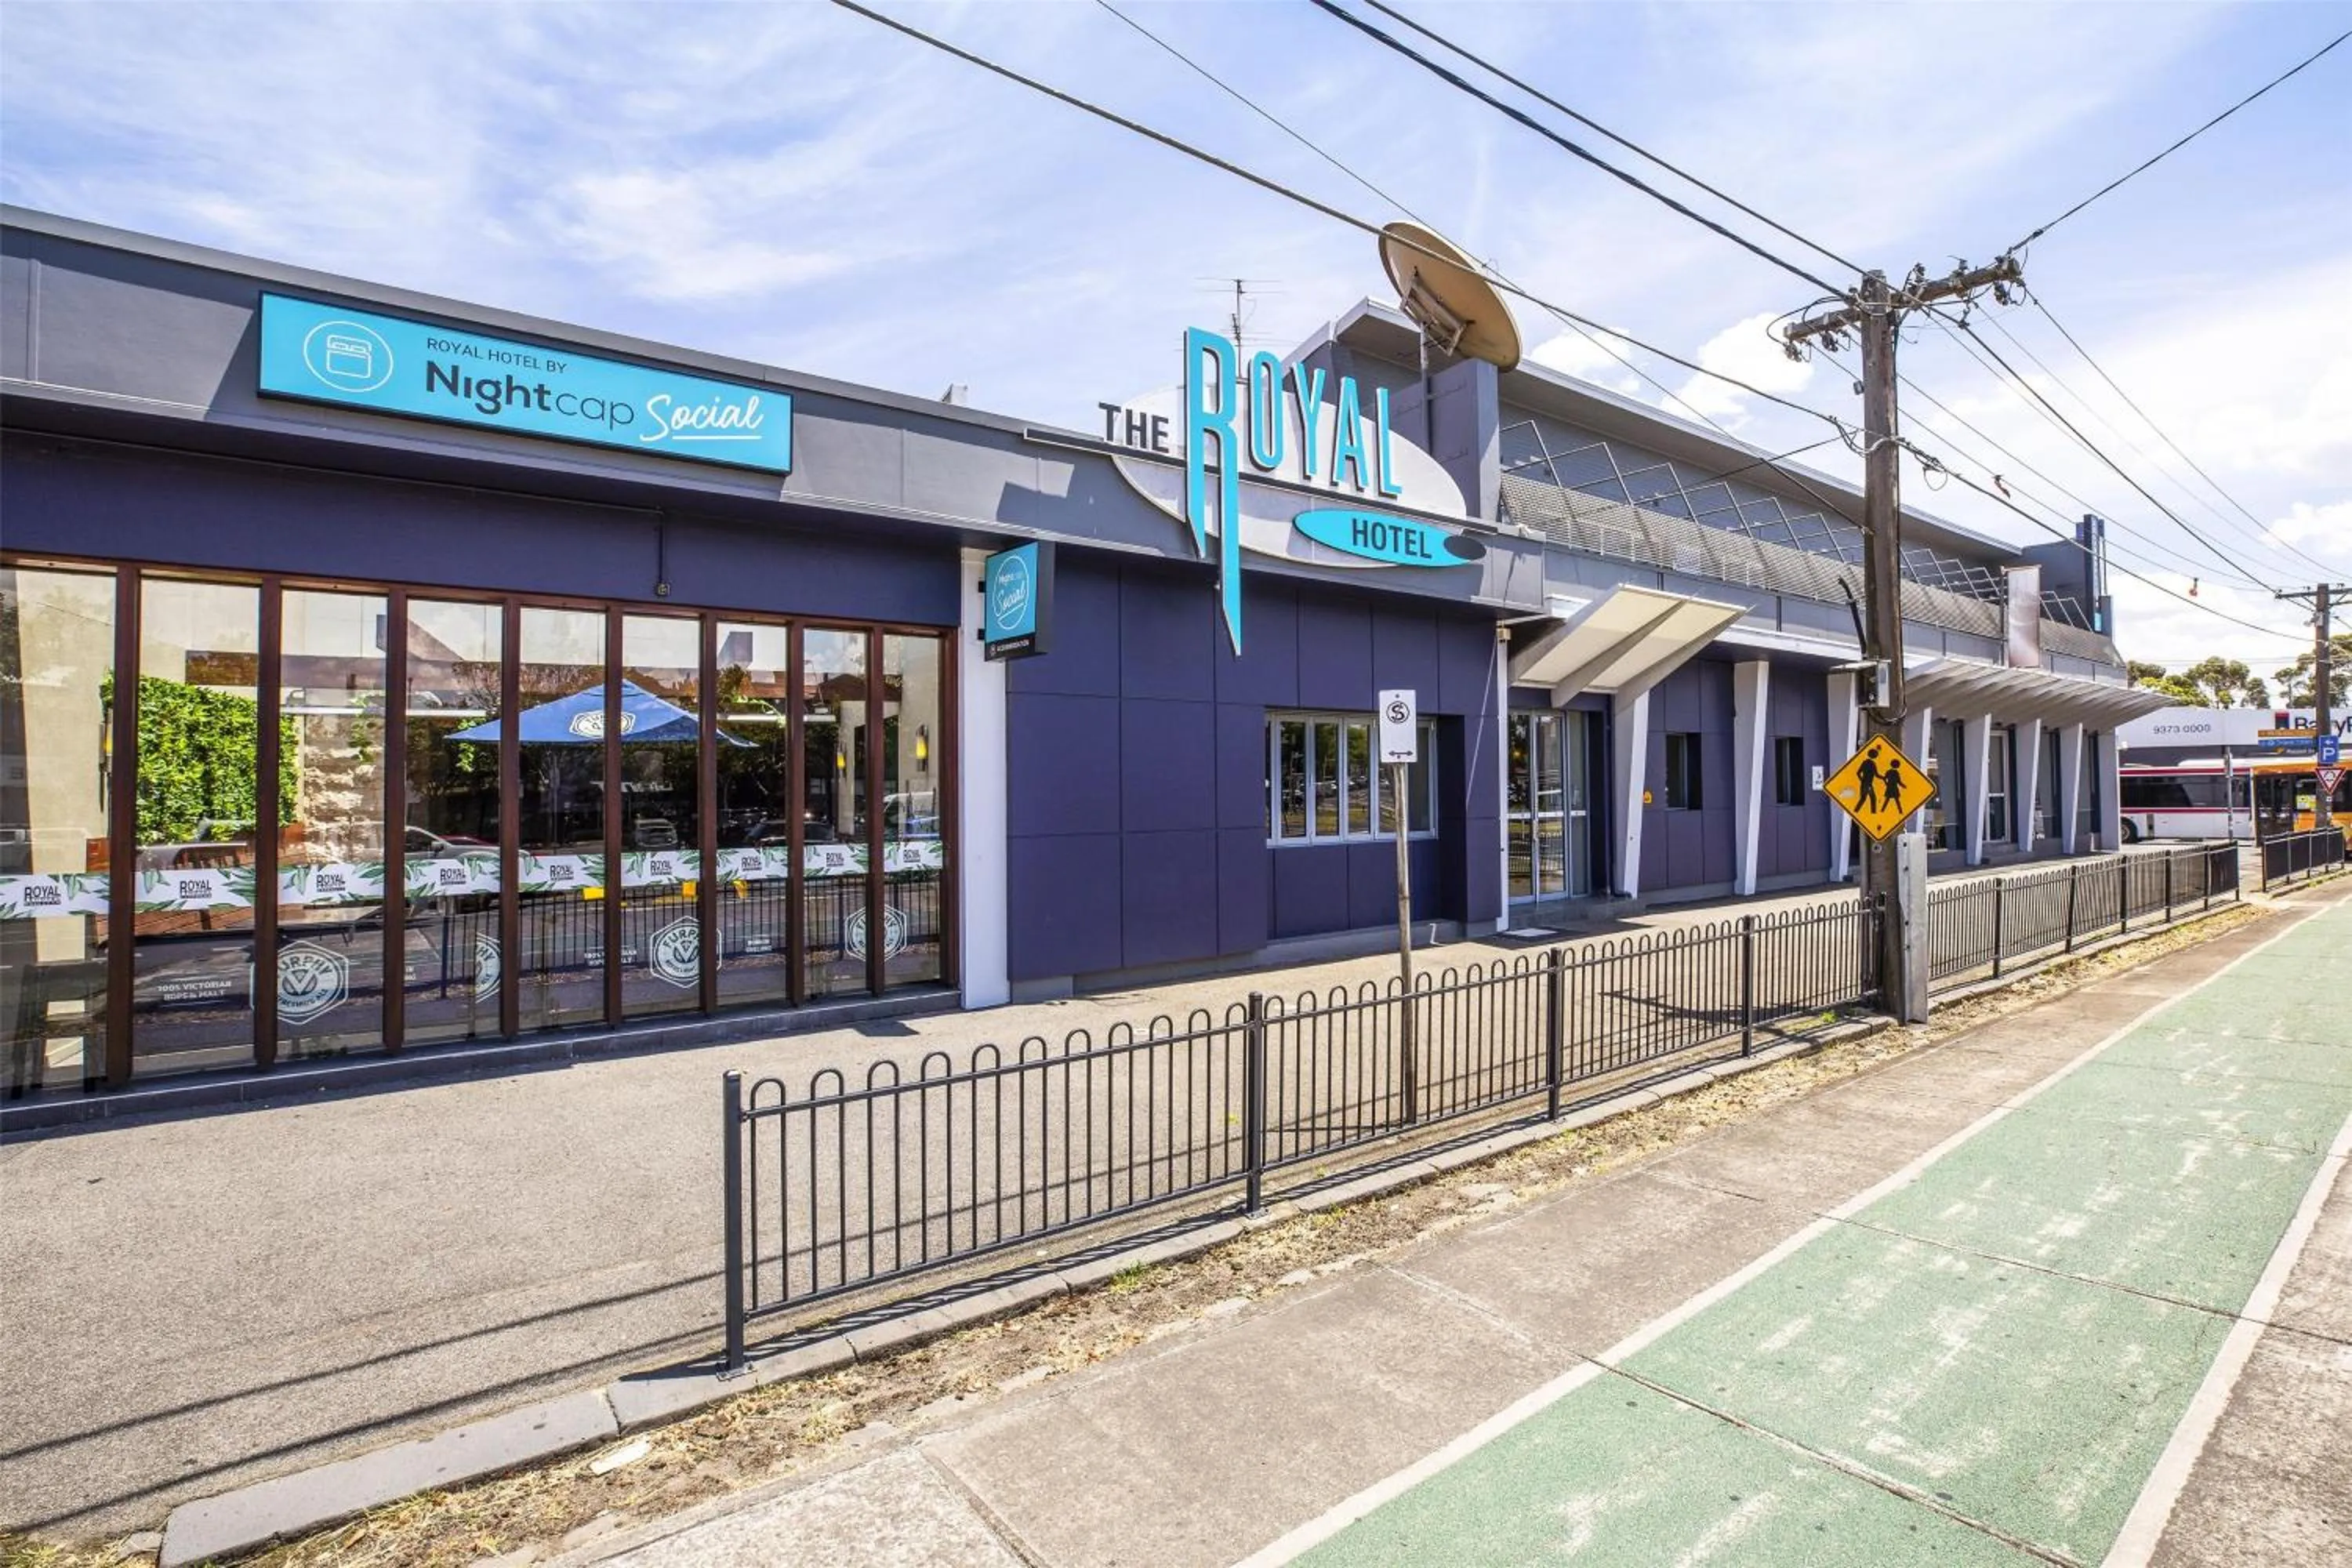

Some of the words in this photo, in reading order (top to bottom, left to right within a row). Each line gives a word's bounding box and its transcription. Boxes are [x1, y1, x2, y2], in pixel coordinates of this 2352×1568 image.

[426, 338, 483, 359] ROYAL
[488, 349, 541, 370] HOTEL
[546, 360, 567, 374] BY
[639, 394, 764, 441] Social
[1098, 402, 1170, 454] THE
[1184, 325, 1403, 660] ROYAL
[1351, 518, 1433, 560] HOTEL
[2323, 747, 2336, 761] P
[440, 868, 466, 881] ROYAL
[550, 865, 573, 877] ROYAL
[650, 860, 673, 873] ROYAL
[180, 880, 212, 896] ROYAL
[316, 873, 345, 887] ROYAL
[24, 885, 61, 902] ROYAL
[662, 929, 700, 948] FURP
[278, 956, 333, 975] URPHY
